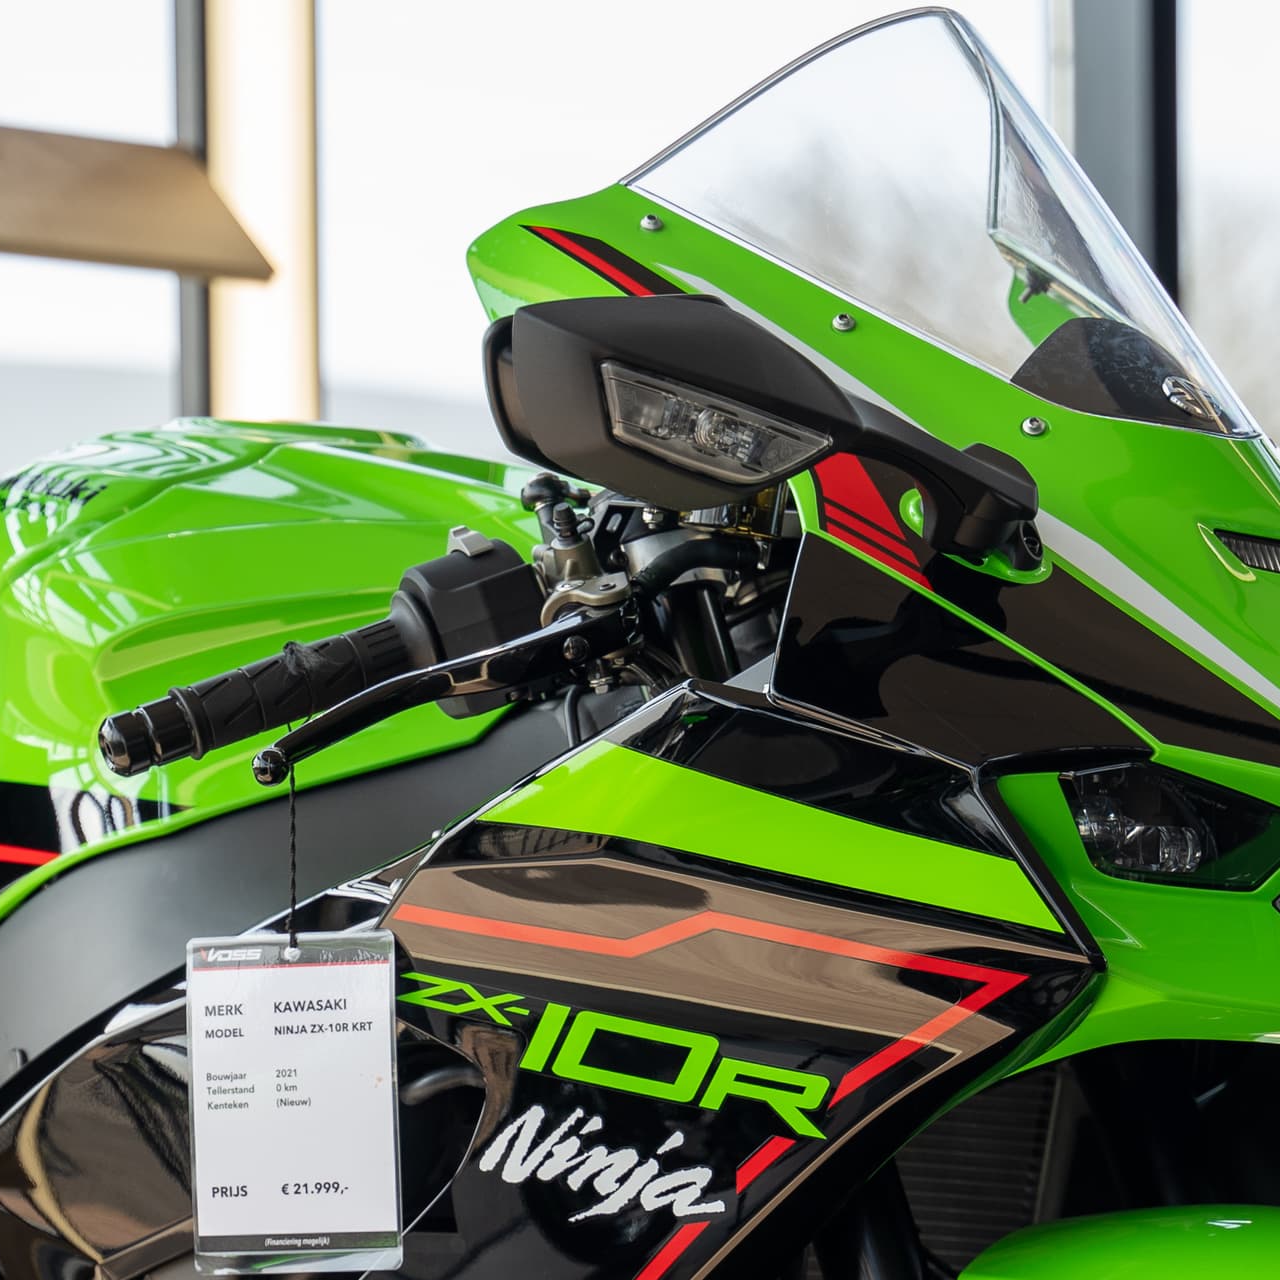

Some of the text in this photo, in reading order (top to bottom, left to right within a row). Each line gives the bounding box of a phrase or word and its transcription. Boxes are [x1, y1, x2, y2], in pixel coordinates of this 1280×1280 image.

[204, 998, 347, 1017] MERK KAWASAKI
[204, 1021, 373, 1039] MODEL NINJA ZX-10R KRT
[397, 971, 831, 1140] ZX-10R
[206, 1068, 298, 1083] Bouwjaar 2021
[206, 1082, 298, 1096] Tellerstand 0 km
[207, 1097, 312, 1111] Kenteken (Nieuw)
[479, 1104, 726, 1223] Ninja
[212, 1181, 349, 1198] PRIJS € 21.999,-
